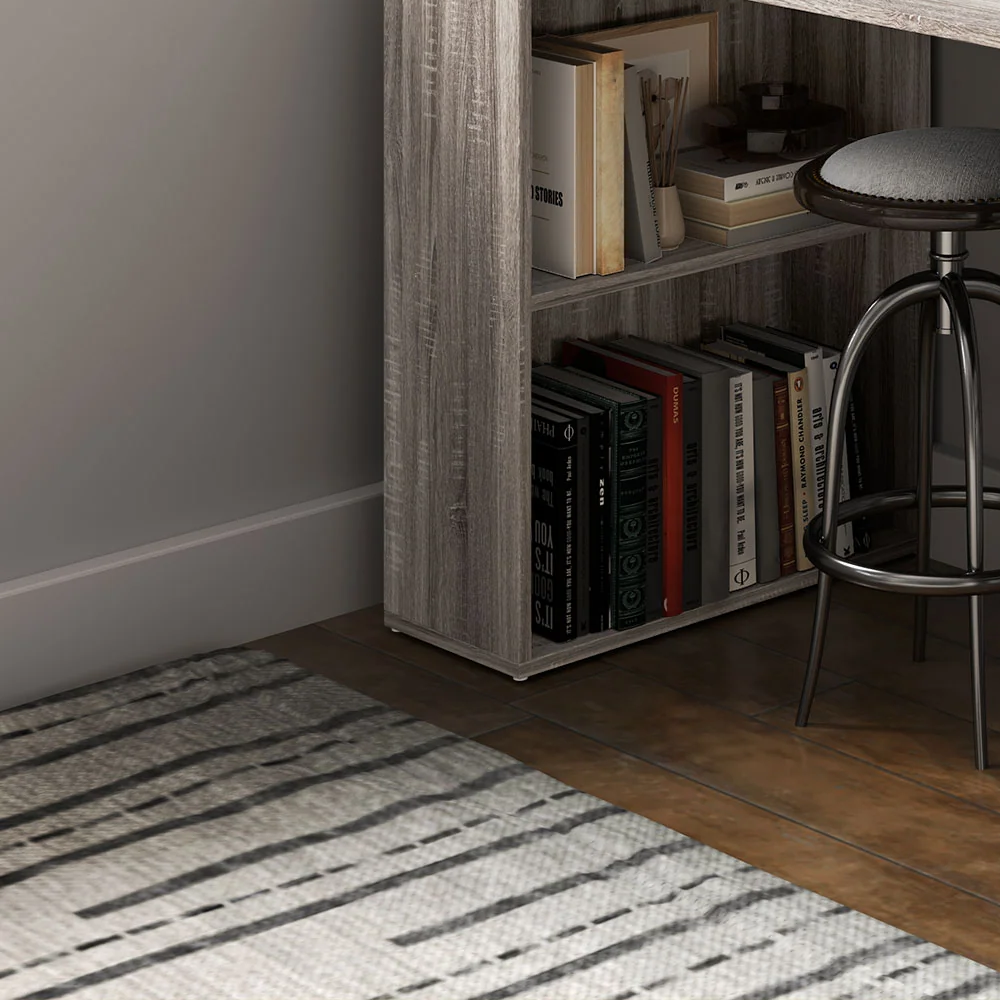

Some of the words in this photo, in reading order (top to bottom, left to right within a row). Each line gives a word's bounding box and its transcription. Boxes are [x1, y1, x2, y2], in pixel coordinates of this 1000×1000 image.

[535, 185, 563, 207] STORIES
[734, 382, 743, 392] IT'S
[735, 393, 743, 402] NOT
[735, 403, 743, 413] HOW
[735, 414, 743, 427] GOOD
[796, 398, 804, 442] CHANDLER
[812, 407, 824, 429] arts
[735, 427, 743, 437] YOU
[734, 438, 744, 449] ARE,
[686, 442, 698, 465] arts
[736, 449, 744, 459] IT'S
[736, 459, 744, 470] HOW
[799, 445, 807, 488] RAYMOND
[736, 494, 745, 507] WANT
[686, 483, 699, 552] architecture
[535, 520, 553, 550] YOU
[738, 529, 746, 541] Paul
[738, 542, 746, 555] Arden
[535, 547, 553, 576] IT'S
[534, 574, 553, 602] GOO
[535, 601, 553, 630] IT'S
